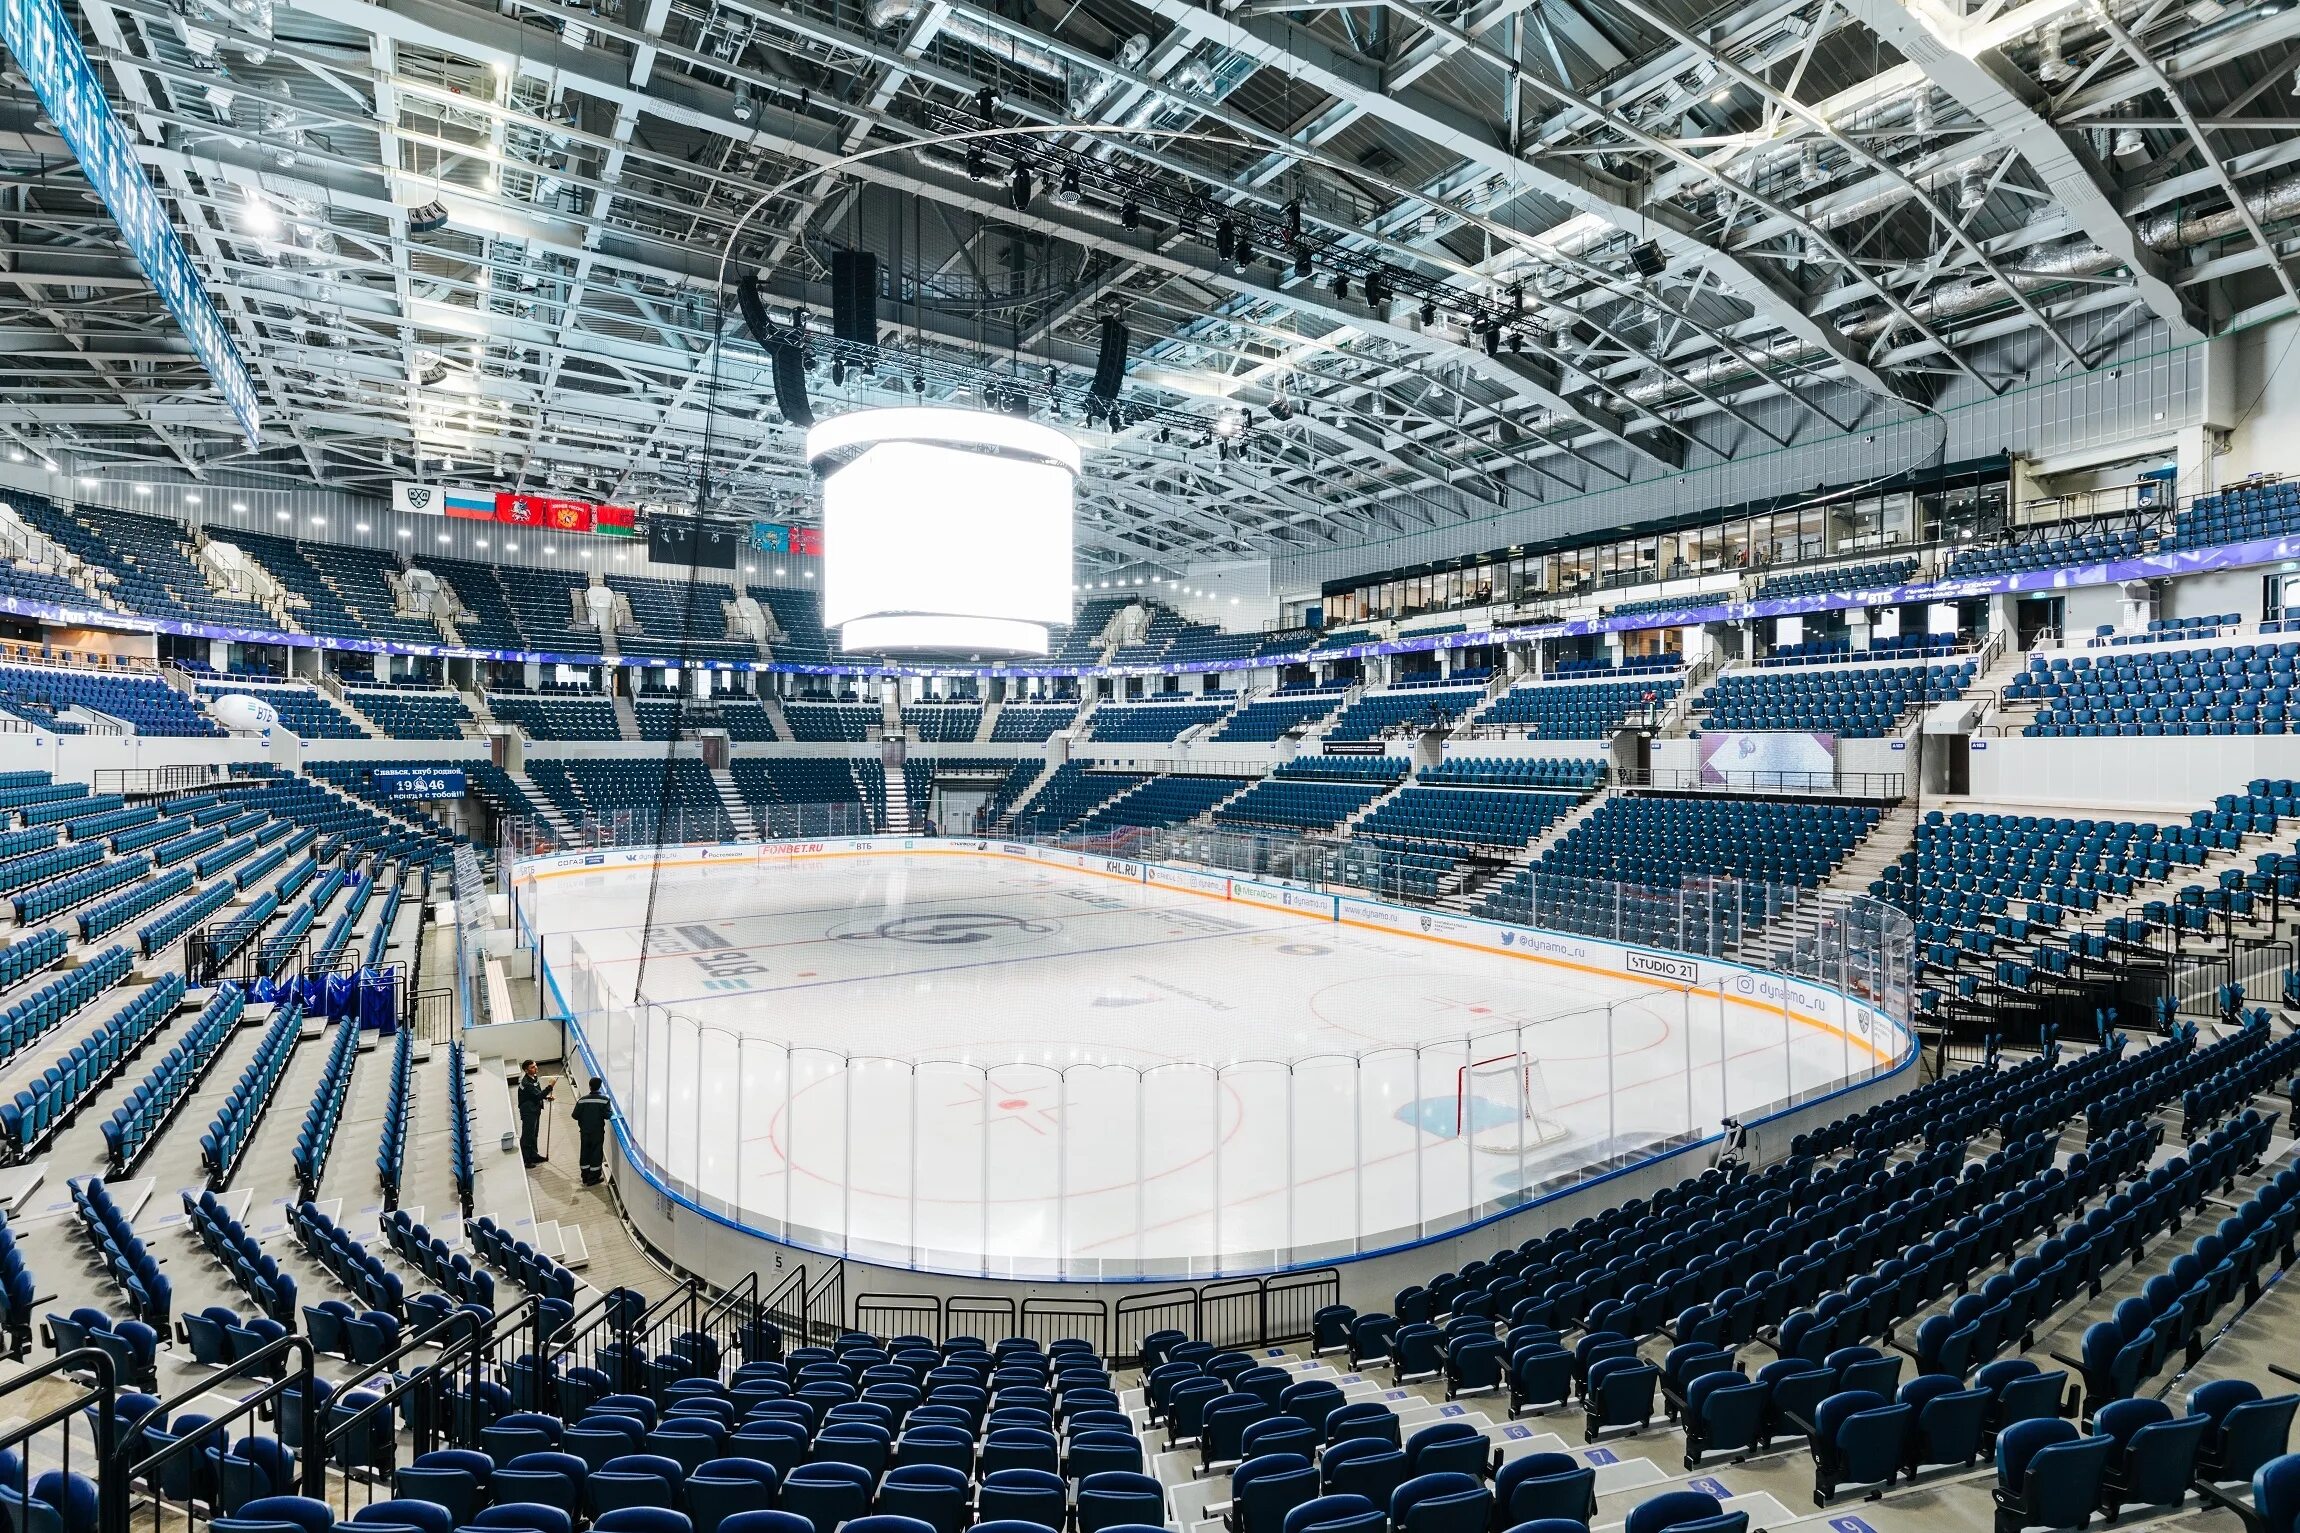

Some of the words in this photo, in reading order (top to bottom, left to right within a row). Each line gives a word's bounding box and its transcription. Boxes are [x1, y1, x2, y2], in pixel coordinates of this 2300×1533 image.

[1868, 592, 1893, 604] ВТБ
[256, 706, 273, 722] ВТБ
[412, 768, 431, 776] клуб
[433, 768, 464, 776] родной,
[396, 780, 412, 791] 19
[429, 780, 445, 790] 46
[763, 844, 824, 854] FONBET.RU
[856, 842, 872, 850] ВТБ
[557, 858, 584, 867] СОГАЗ
[1106, 860, 1137, 876] KHL.RU
[1293, 896, 1328, 910] dynamo.ru
[1344, 906, 1398, 922] www.dynamo.ru
[1519, 935, 1586, 958] @dynamo_ru
[1632, 957, 1676, 976] STUDIO
[1680, 966, 1693, 978] 21
[1760, 981, 1825, 1012] dynamo_ru
[775, 1256, 783, 1268] 5
[1447, 1407, 1458, 1416] 5
[1512, 1427, 1524, 1437] 6
[1591, 1451, 1606, 1465] 7
[1815, 1454, 1820, 1463] 8
[1700, 1481, 1716, 1494] 8
[1841, 1520, 1862, 1533] 9
